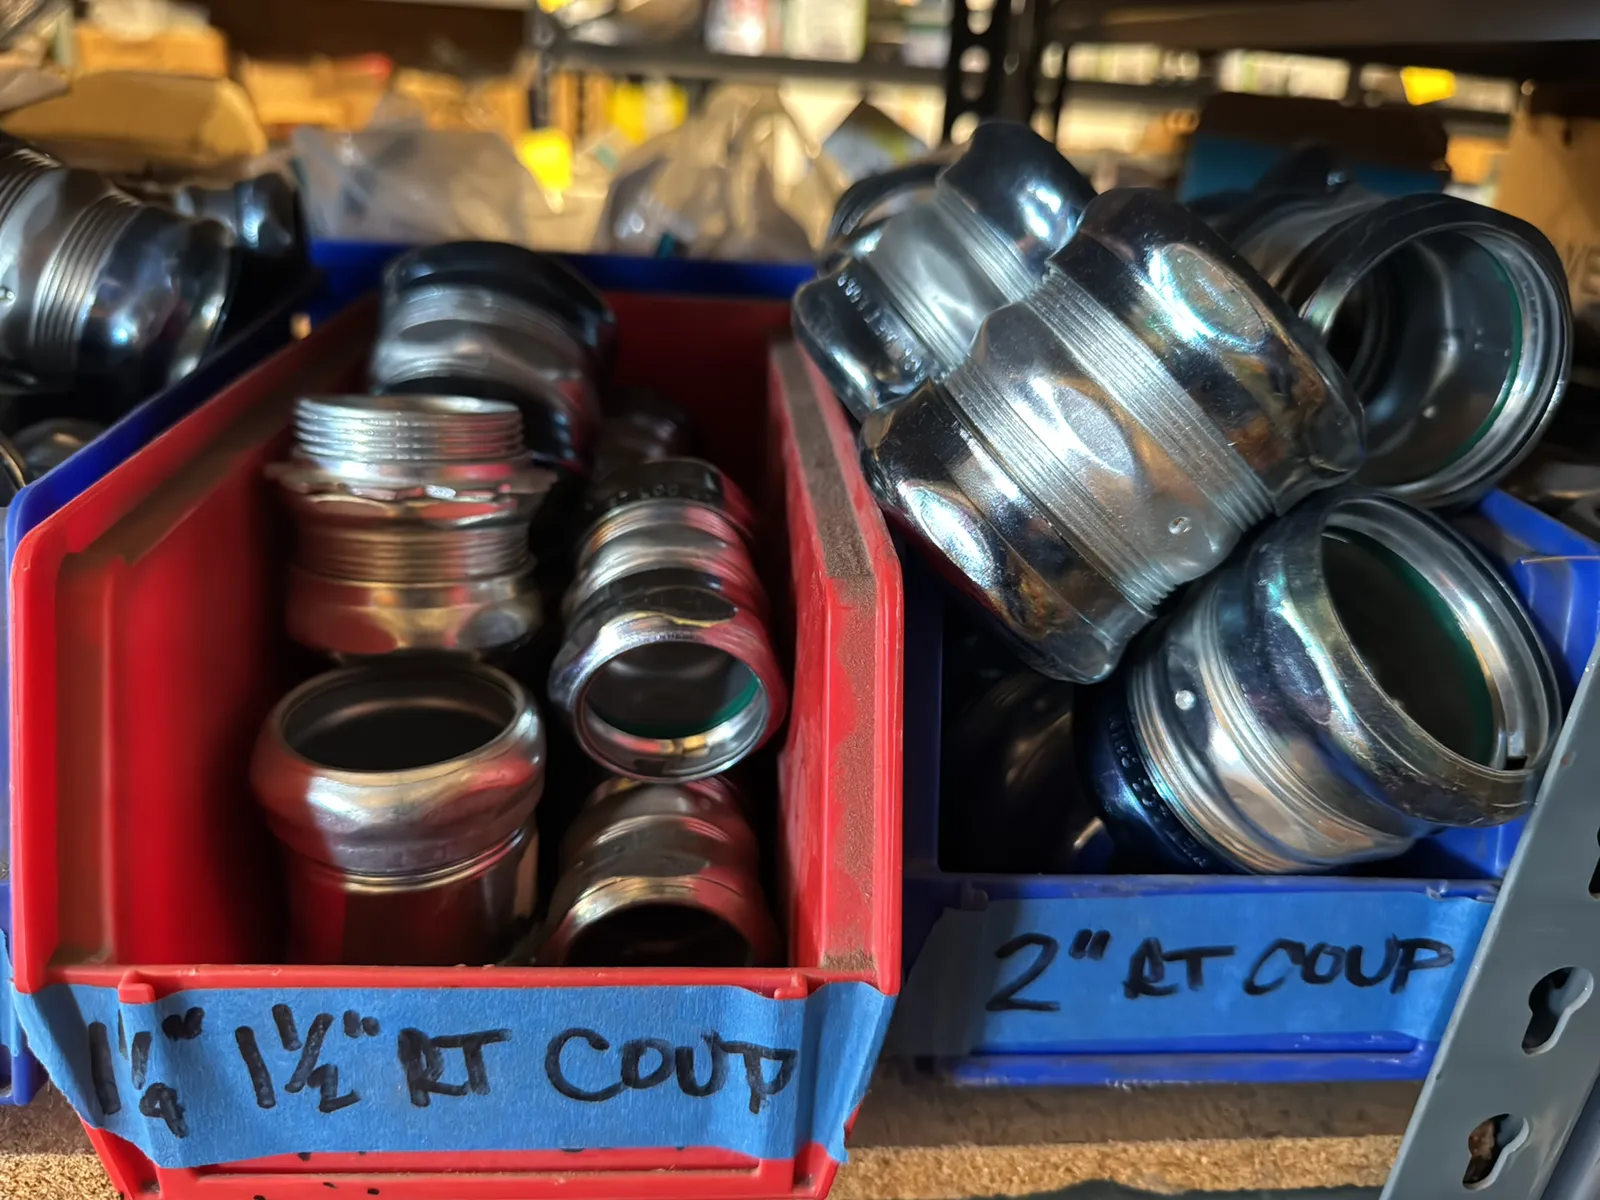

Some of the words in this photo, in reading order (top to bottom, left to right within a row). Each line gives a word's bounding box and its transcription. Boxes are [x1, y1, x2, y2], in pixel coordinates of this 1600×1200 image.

[986, 929, 1110, 1011] 2"
[1123, 937, 1237, 999] RT
[1243, 933, 1454, 995] COUP
[397, 1027, 512, 1107] RT
[544, 1027, 798, 1114] COUP
